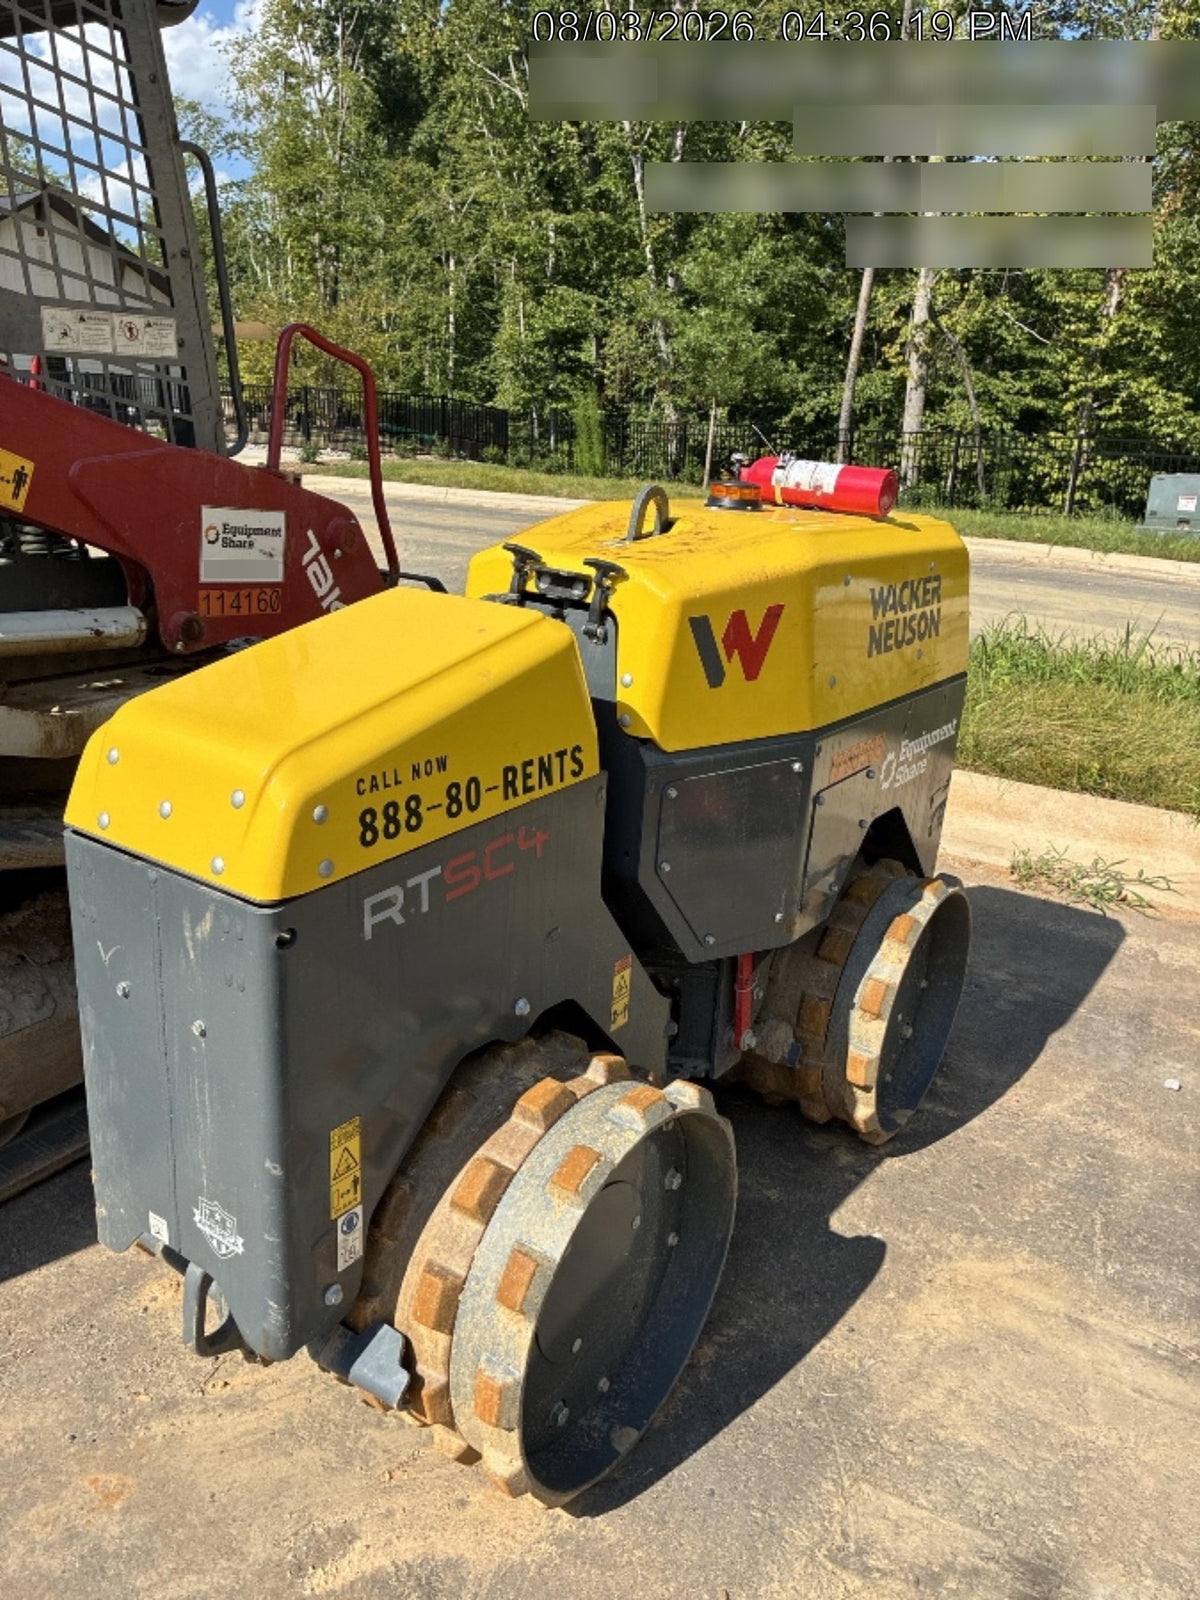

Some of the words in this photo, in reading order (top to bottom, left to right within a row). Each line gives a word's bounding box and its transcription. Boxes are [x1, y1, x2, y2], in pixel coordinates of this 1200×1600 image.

[221, 537, 255, 549] Share
[222, 523, 282, 538] Equipment
[202, 590, 280, 615] 114160
[869, 575, 941, 620] WACKER
[867, 608, 941, 658] NEUSON
[899, 718, 957, 762] Equipment
[356, 769, 402, 796] CALL
[411, 755, 448, 780] NOW
[894, 758, 928, 788] Share
[358, 744, 585, 848] 888-80-RENTS
